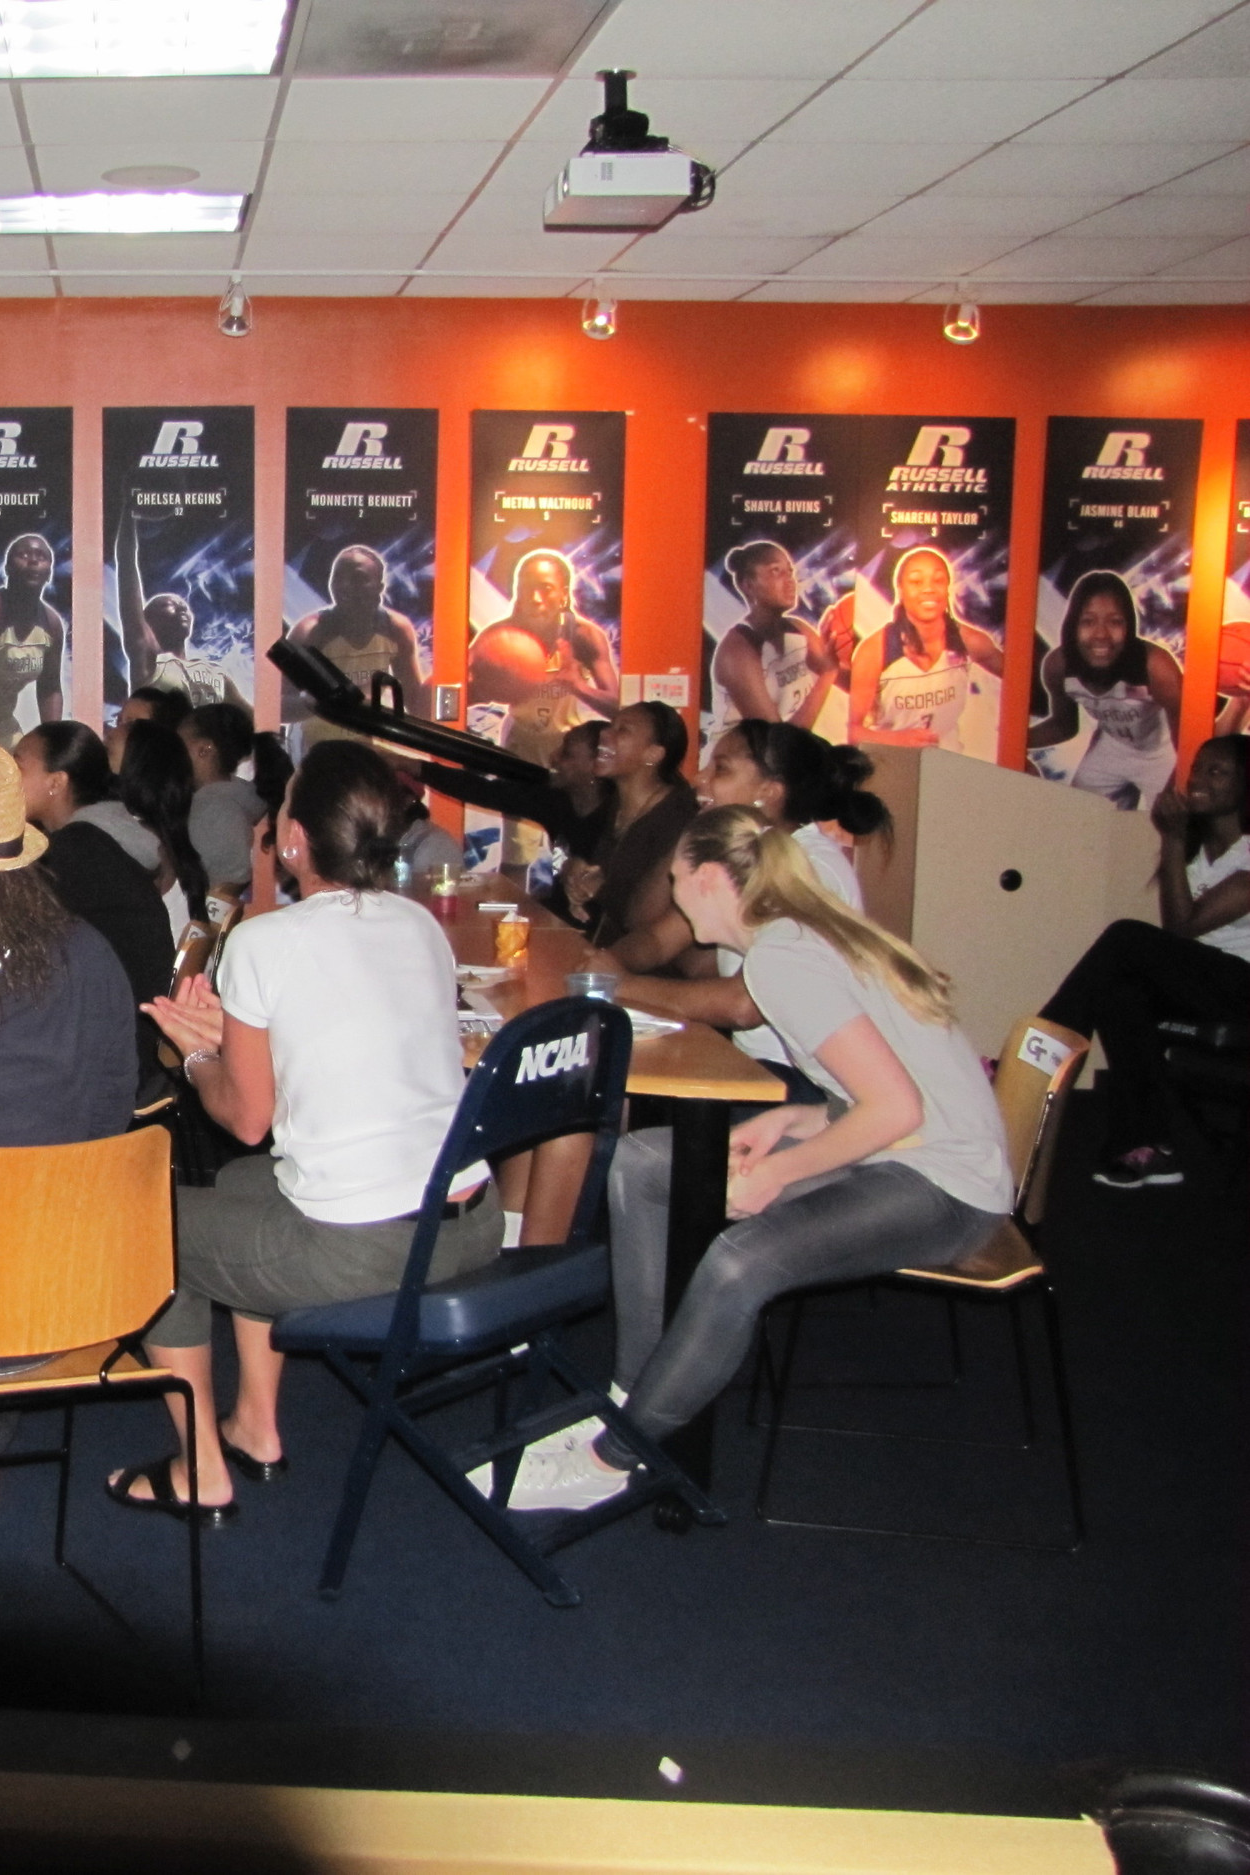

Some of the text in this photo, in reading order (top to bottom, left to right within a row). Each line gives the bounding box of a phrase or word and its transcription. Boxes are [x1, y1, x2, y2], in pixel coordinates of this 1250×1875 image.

[139, 455, 220, 468] RUSSELL
[321, 456, 403, 470] RUSSELL
[507, 458, 590, 472] RUSSELL
[742, 461, 825, 476] RUSSELL
[889, 466, 987, 482] RUSSELL
[1081, 465, 1165, 480] RUSSELL
[884, 482, 988, 494] ATHLETIC
[137, 493, 222, 505] CHELSEA REGINS
[311, 494, 413, 507] MONNETTE BENNETT
[538, 496, 593, 510] WALTHOUR
[744, 500, 821, 513] SHAYLA BIVINS
[1080, 504, 1159, 519] JASMINE BLAIN
[891, 510, 979, 525] SHARENA TAYLOR
[894, 686, 956, 711] GEORGIA
[515, 1031, 590, 1084] NCAA
